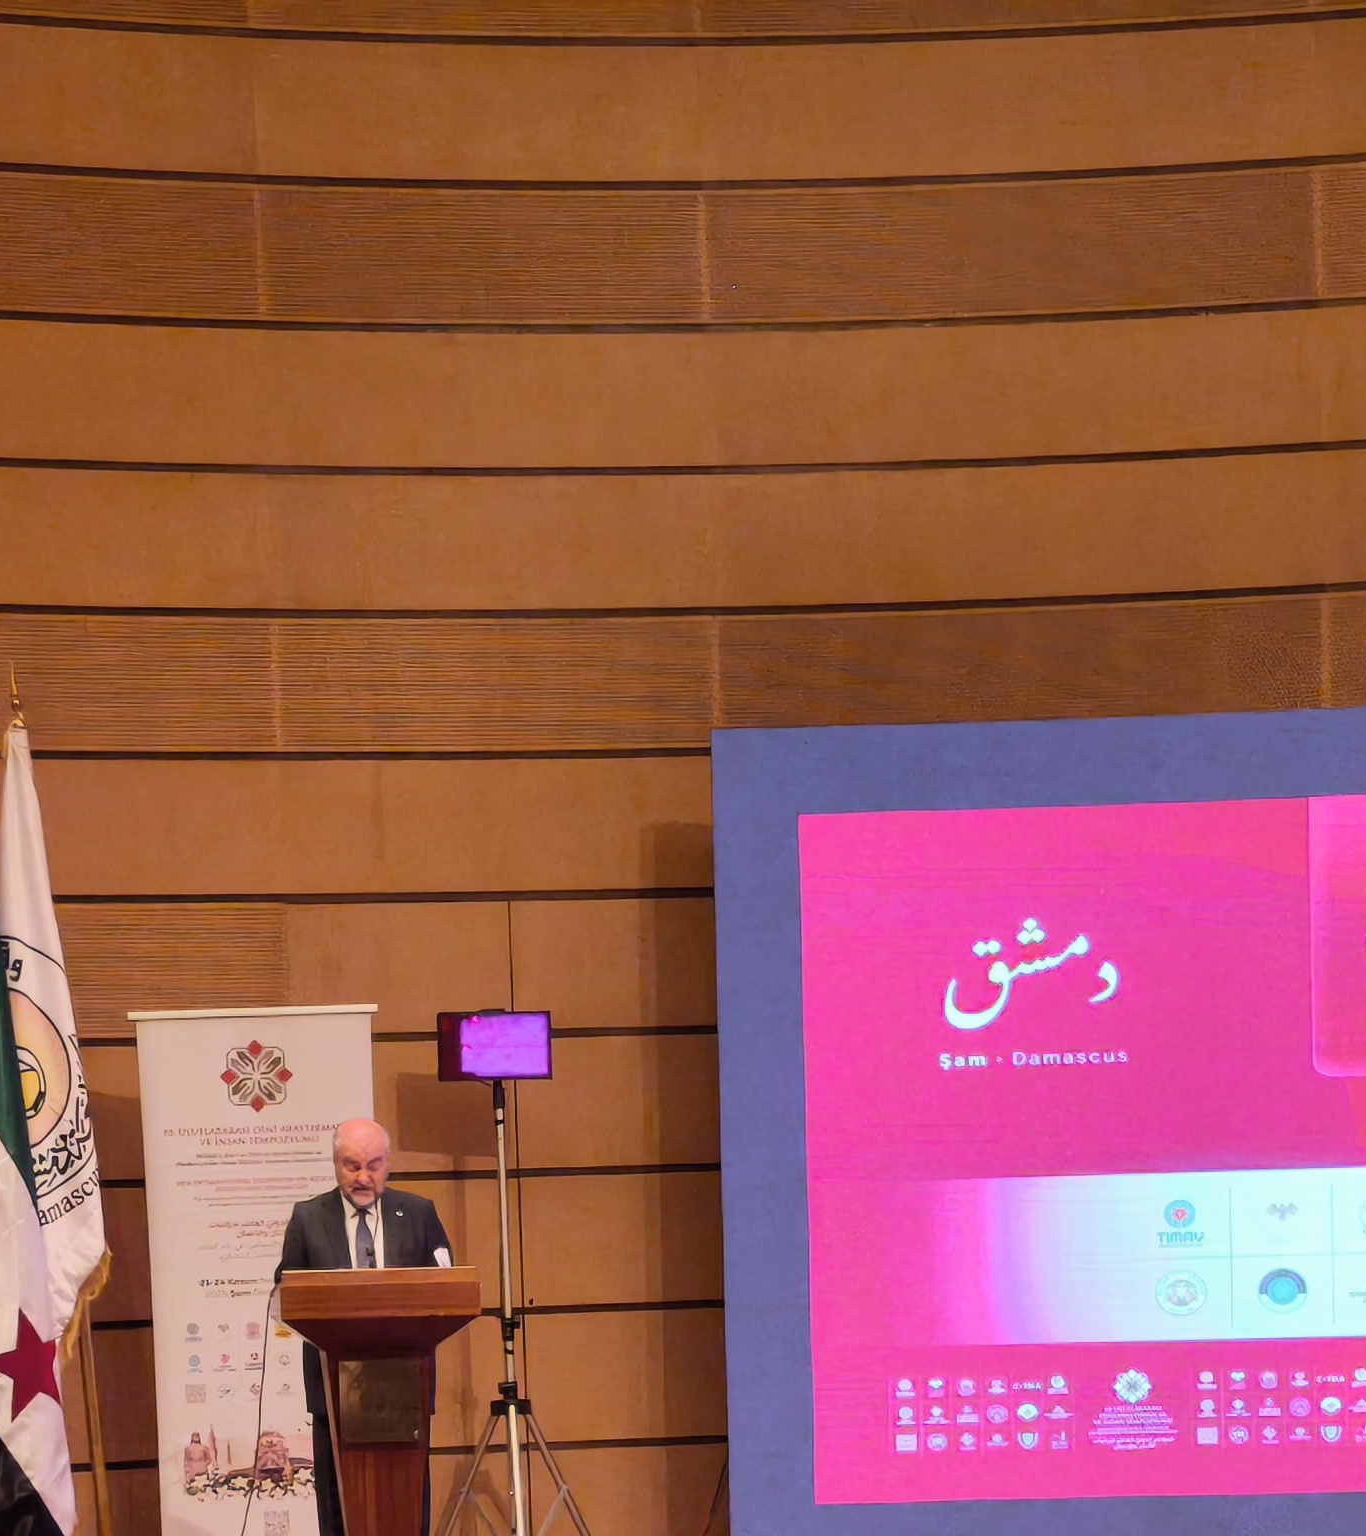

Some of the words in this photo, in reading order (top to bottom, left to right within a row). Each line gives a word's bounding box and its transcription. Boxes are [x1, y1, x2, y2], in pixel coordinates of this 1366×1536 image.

[944, 917, 1119, 1030] دمشق
[939, 1053, 987, 1070] Şam
[1012, 1050, 1128, 1066] Damascus
